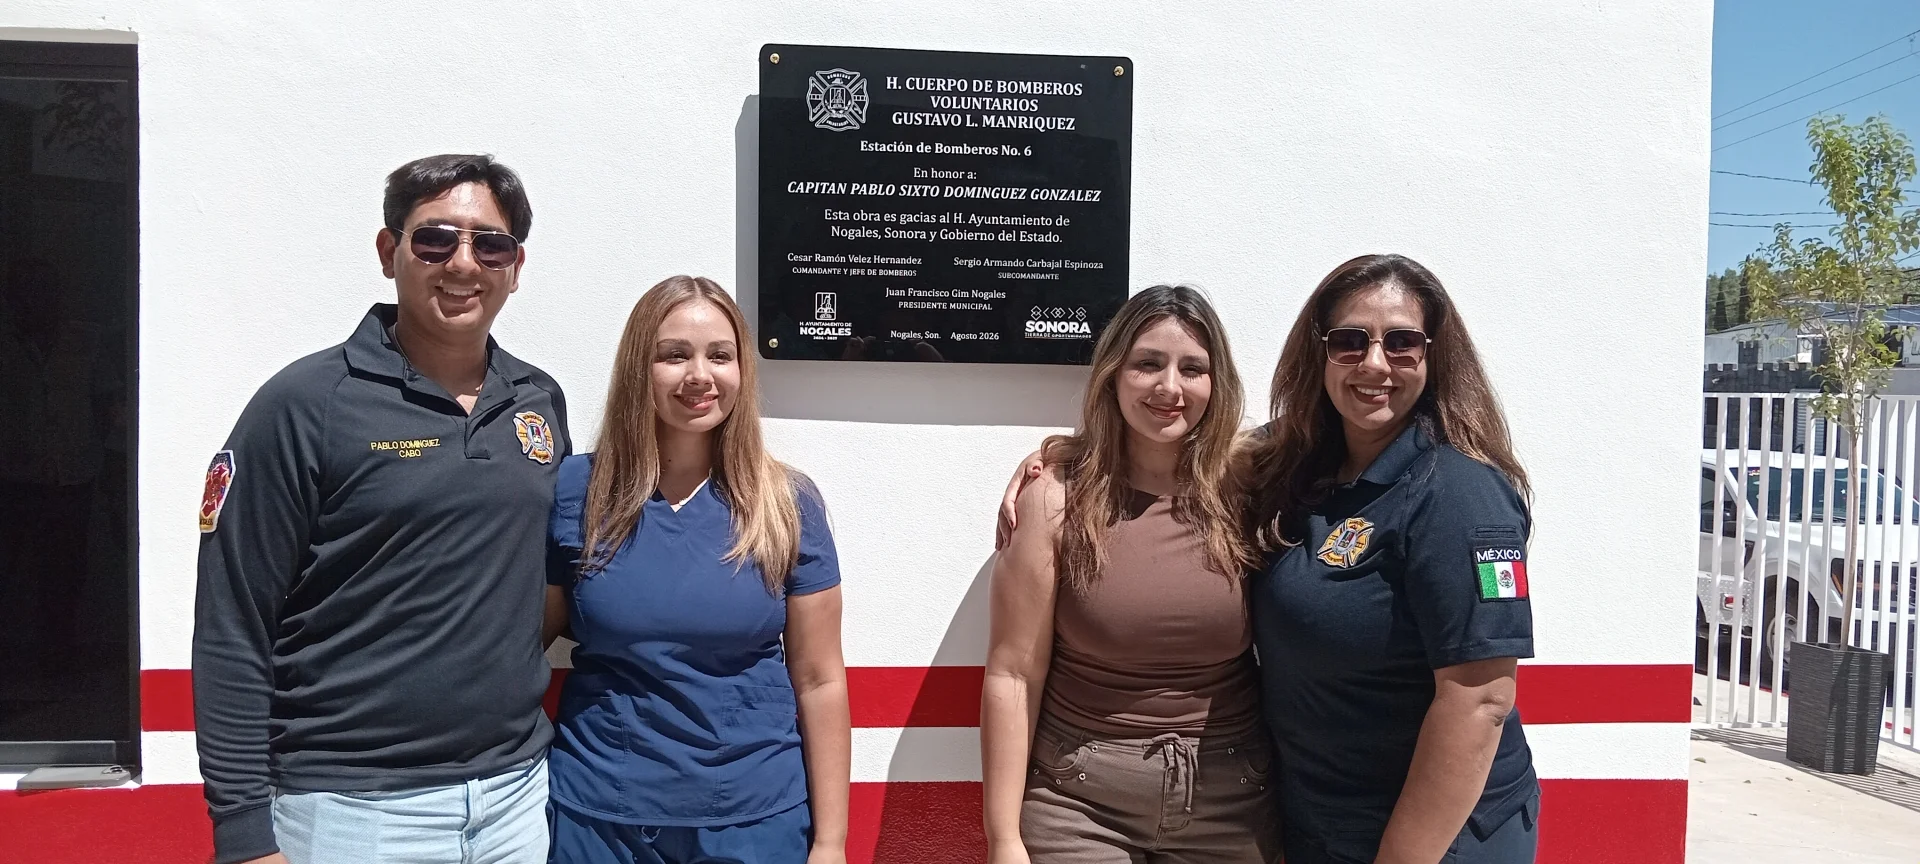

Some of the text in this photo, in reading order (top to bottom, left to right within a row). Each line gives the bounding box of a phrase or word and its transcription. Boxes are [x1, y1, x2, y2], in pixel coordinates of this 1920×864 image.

[886, 76, 1083, 96] H. CUERPO DE BOMBEROS
[930, 95, 1038, 112] VOLUNTARIOS
[892, 112, 1075, 132] GUSTAVO L. MANRIQUEZ
[860, 140, 1032, 156] Estación de Bomberos No. 6
[914, 167, 977, 179] En honor a:
[787, 181, 1102, 202] CAPITAN PABLO SIXTO DOMINGUEZ GONZALEZ
[825, 209, 1070, 227] Esta obra es gacias al H. Ayuntamiento de
[831, 226, 1062, 243] Nogales, Sonora y Gobierno del Estado.
[787, 253, 922, 264] Cesar Ramón Velez Hernandez
[954, 257, 1103, 270] Sergio Armando Carbajal Espinoza
[850, 268, 865, 276] JEFE
[998, 272, 1059, 280] SUBCOMANDANTE
[885, 287, 1006, 300] Juan Francisco Gim Nogales
[898, 301, 947, 309] PRESIDENTE
[800, 326, 852, 336] NOGALES
[1025, 320, 1092, 334] SONORA
[890, 330, 941, 340] Nogales, Son.
[950, 332, 999, 341] Agosto 2026
[370, 438, 441, 451] PABLO DOMINGUEZ
[398, 449, 422, 458] CABO
[1476, 548, 1521, 562] MÉXICO
